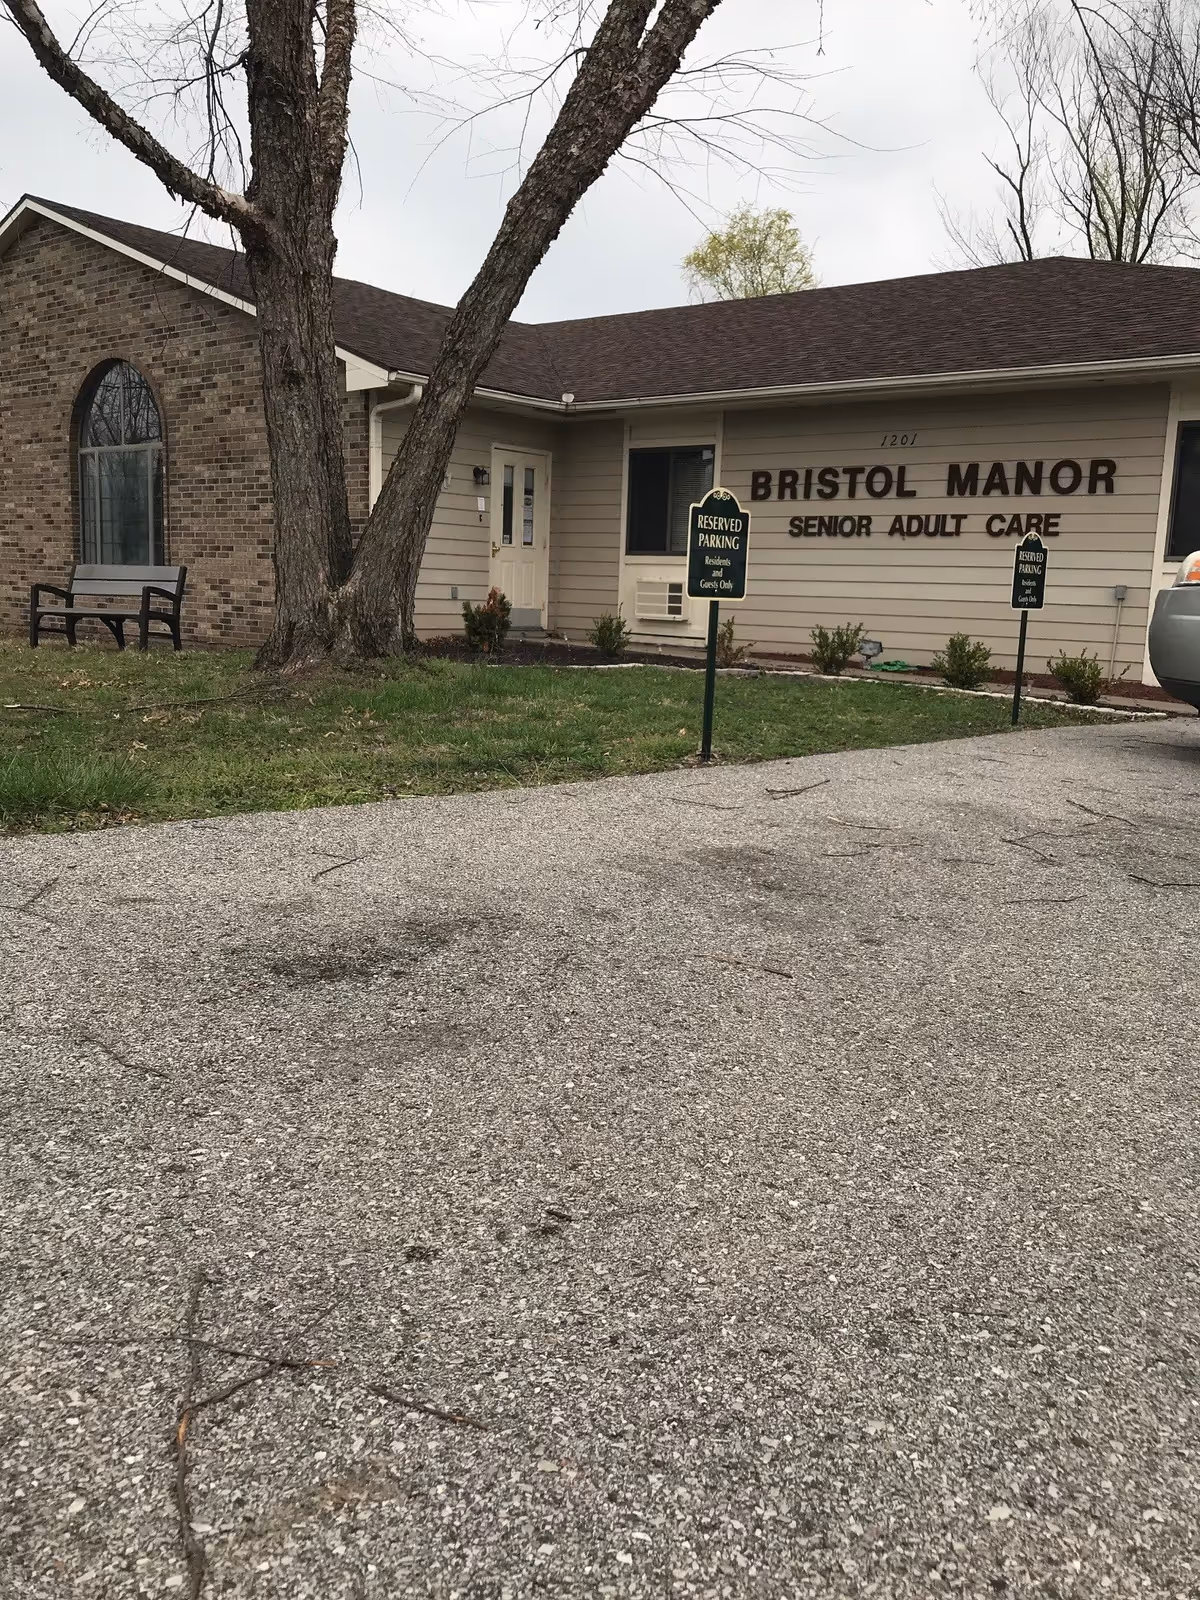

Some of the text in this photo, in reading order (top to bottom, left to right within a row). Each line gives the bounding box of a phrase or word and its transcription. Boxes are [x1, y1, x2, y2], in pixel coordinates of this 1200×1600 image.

[880, 433, 917, 447] 1201
[750, 459, 1117, 500] BRISTOL MANOR
[698, 514, 742, 532] RESERVED
[788, 513, 1061, 538] SENIOR ADULT CARE
[698, 533, 740, 549] PARKING
[705, 556, 731, 566] Residents
[1019, 551, 1043, 562] RESERVED
[712, 568, 723, 578] and
[1019, 564, 1041, 574] PARKING
[700, 579, 733, 592] Guests Only
